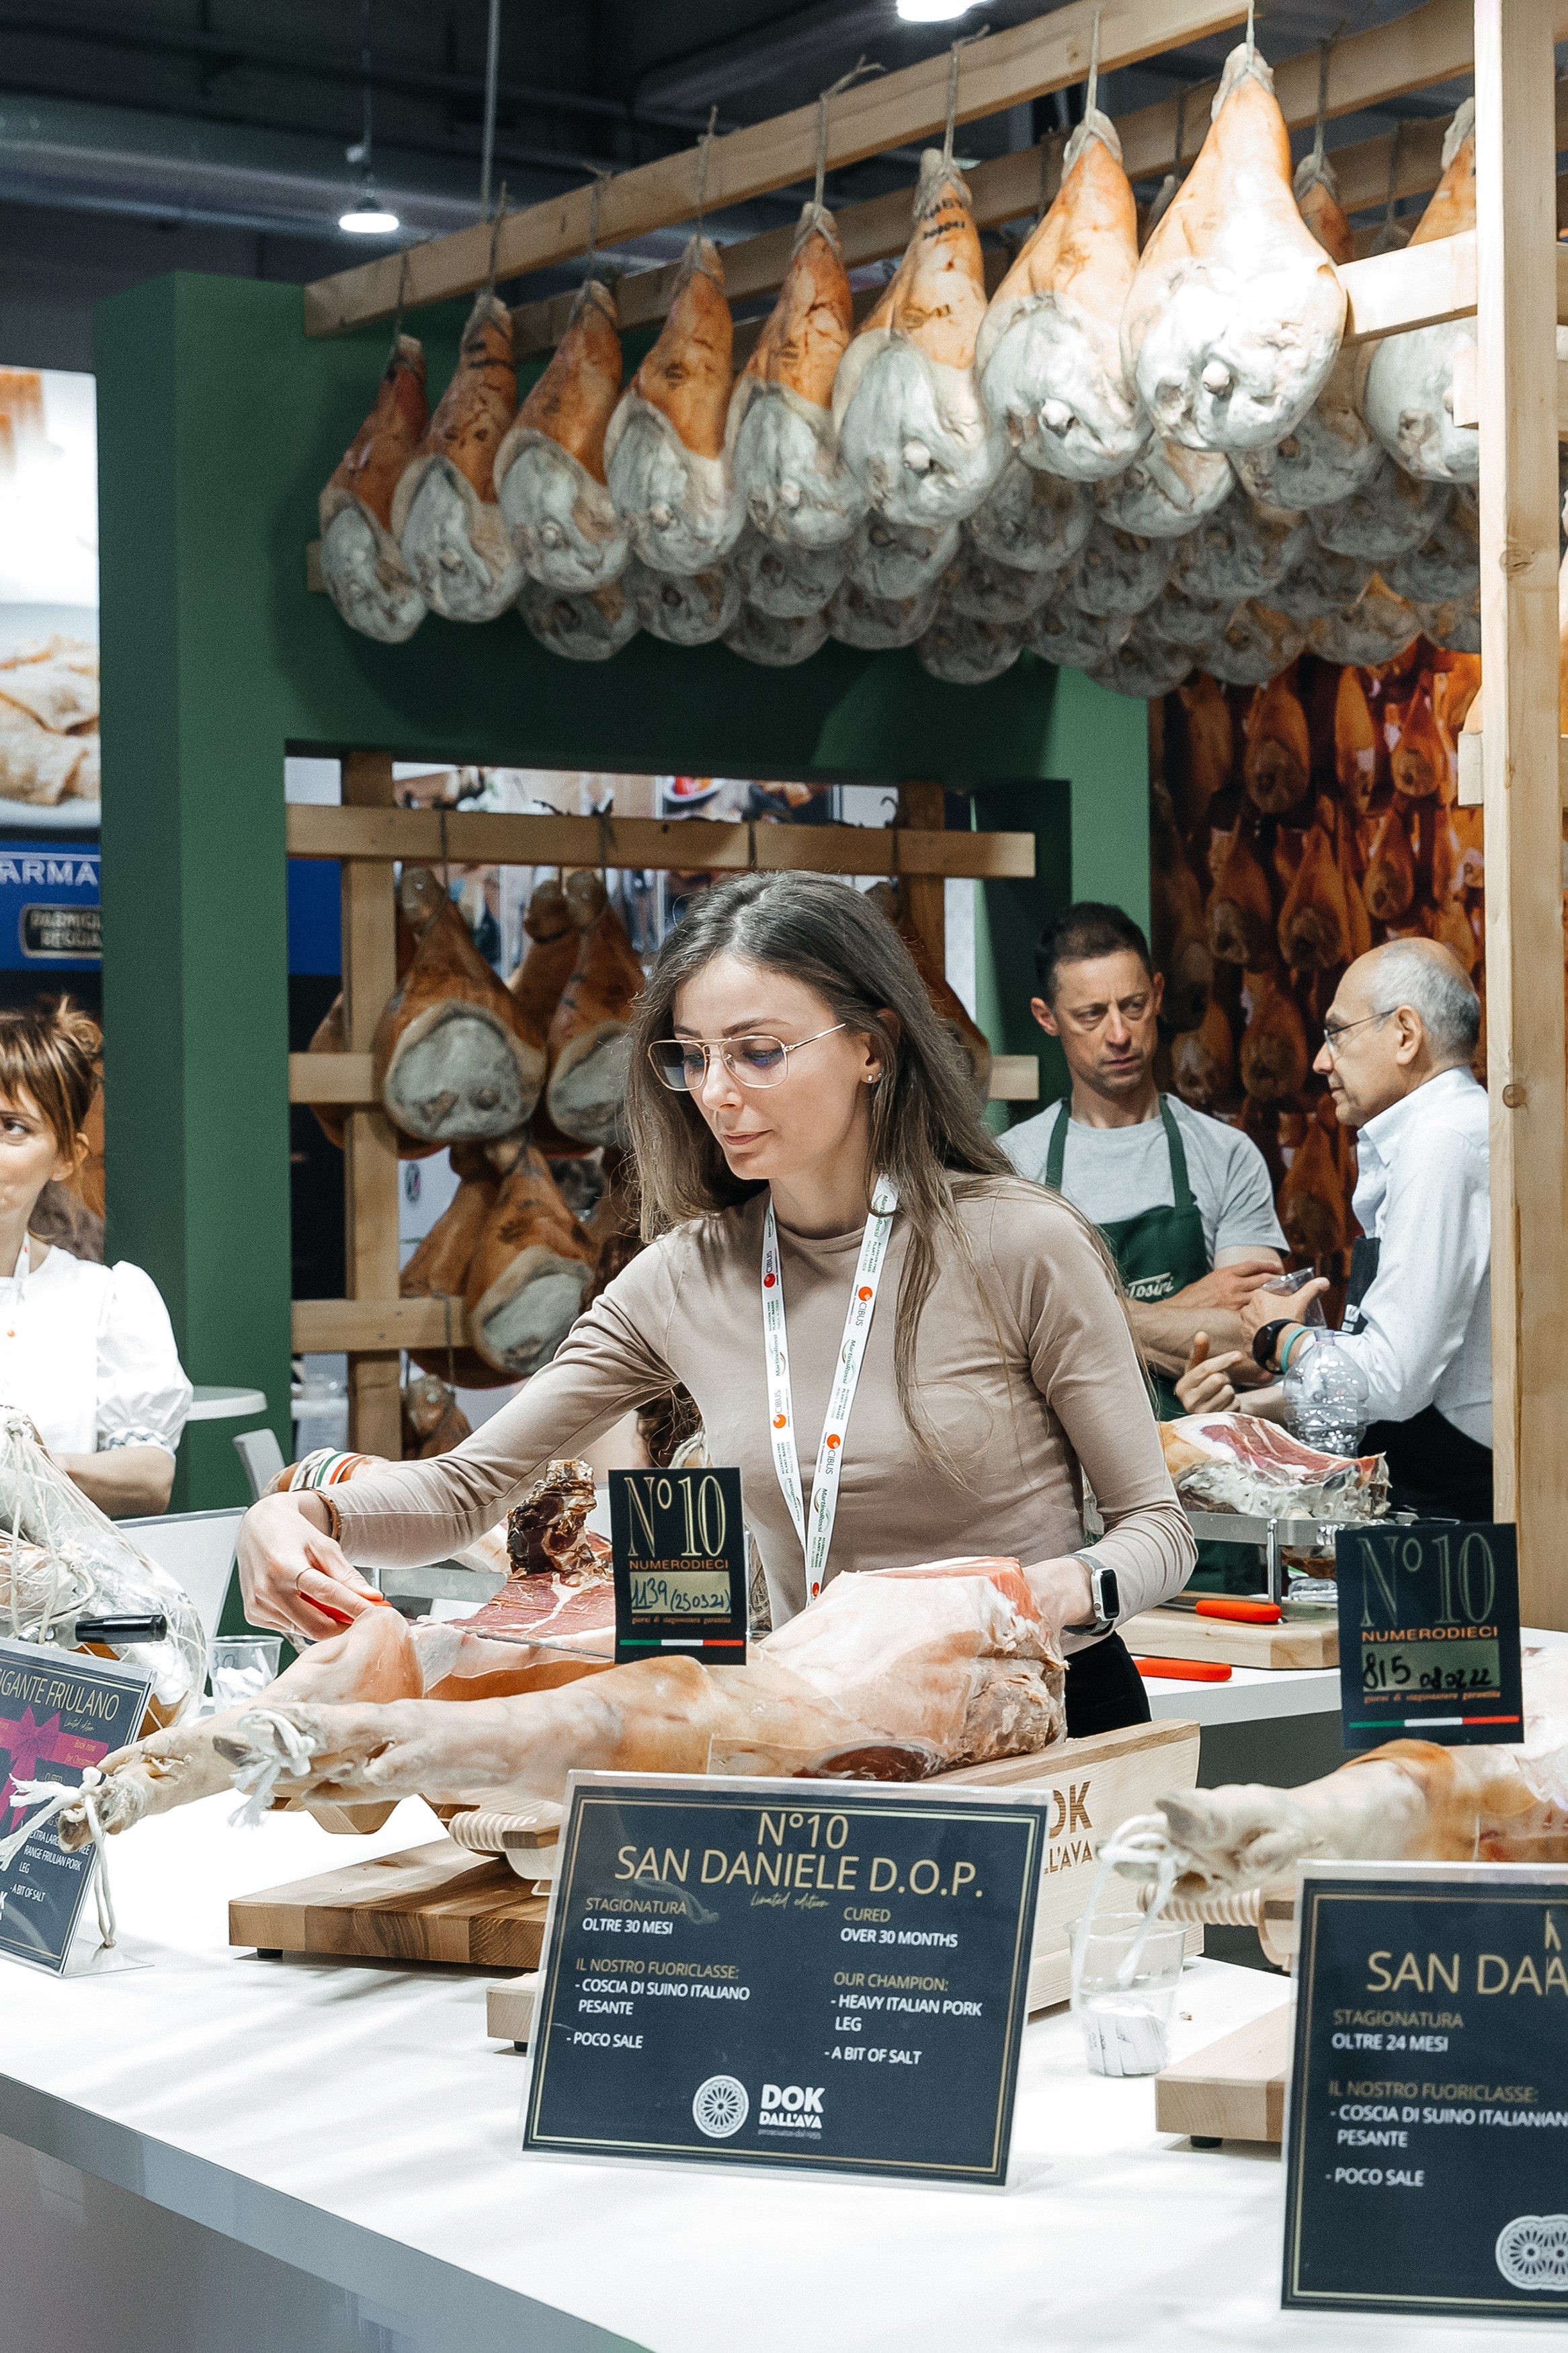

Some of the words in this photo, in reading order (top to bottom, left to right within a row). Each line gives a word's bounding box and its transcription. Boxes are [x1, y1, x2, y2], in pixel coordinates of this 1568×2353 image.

[856, 1302, 867, 1326] CIBUS
[843, 1339, 856, 1384] MartinoRossi
[774, 1390, 782, 1414] CIBUS
[825, 1449, 836, 1474] CIBUS
[818, 1488, 828, 1533] MartinoRossi
[629, 1559, 729, 1570] NUMERODIECI
[1362, 1626, 1497, 1642] NUMERODIECI
[1363, 1652, 1411, 1689] 815
[0, 1668, 48, 1704] IGANTE
[45, 1680, 120, 1721] FRIULANO
[19, 1862, 30, 1874] LEG
[24, 1845, 42, 1860] RANGE
[65, 1858, 82, 1872] PORK
[614, 1845, 690, 1882] SAN
[700, 1849, 860, 1890] DANIELE
[869, 1857, 983, 1899] D.O.P.
[25, 1888, 34, 1898] OF
[32, 1889, 46, 1902] SALT
[585, 1897, 687, 1915] STAGIONATURA
[843, 1907, 891, 1923] CURED
[582, 1917, 622, 1931] OLTRE
[624, 1919, 641, 1933] 30
[643, 1920, 673, 1935] MESI
[840, 1927, 875, 1943] OVER
[878, 1929, 896, 1944] 30
[897, 1931, 958, 1948] MONTHS
[576, 1958, 587, 1971] IL
[589, 1958, 645, 1975] NOSTRO
[648, 1961, 740, 1980] FUORICLASSE:
[1366, 1950, 1460, 1994] SAN
[581, 1978, 628, 1994] COSCIA
[630, 1981, 644, 1995] DI
[646, 1982, 688, 1997] SUINO
[690, 1983, 751, 2001] ITALIANO
[833, 1970, 866, 1986] OUR
[867, 1973, 949, 1992] CHAMPION:
[578, 1999, 634, 2016] PESANTE
[838, 1994, 885, 2010] HEAVY
[886, 1996, 940, 2014] ITALIAN
[942, 2000, 983, 2016] PORK
[835, 2016, 862, 2032] LEG
[1333, 2008, 1464, 2028] STAGIONATURA
[573, 2031, 611, 2047] POCO
[612, 2033, 643, 2049] SALE
[1331, 2032, 1383, 2050] OLTRE
[1386, 2034, 1407, 2051] 24
[1409, 2035, 1448, 2052] MESI
[831, 2046, 841, 2060] A
[843, 2046, 866, 2061] BIT
[867, 2048, 887, 2063] OF
[889, 2050, 922, 2065] SALT
[761, 2083, 825, 2113] DOK
[1328, 2080, 1342, 2097] IL
[1347, 2081, 1418, 2099] NOSTRO
[759, 2111, 823, 2129] DALL'AVA
[1339, 2104, 1399, 2122] COSCIA
[1402, 2107, 1420, 2123] DI
[1422, 2107, 1476, 2125] SUINO
[1337, 2128, 1408, 2147] PESANTE
[1335, 2167, 1383, 2186] POCO
[1386, 2168, 1425, 2187] SALE
